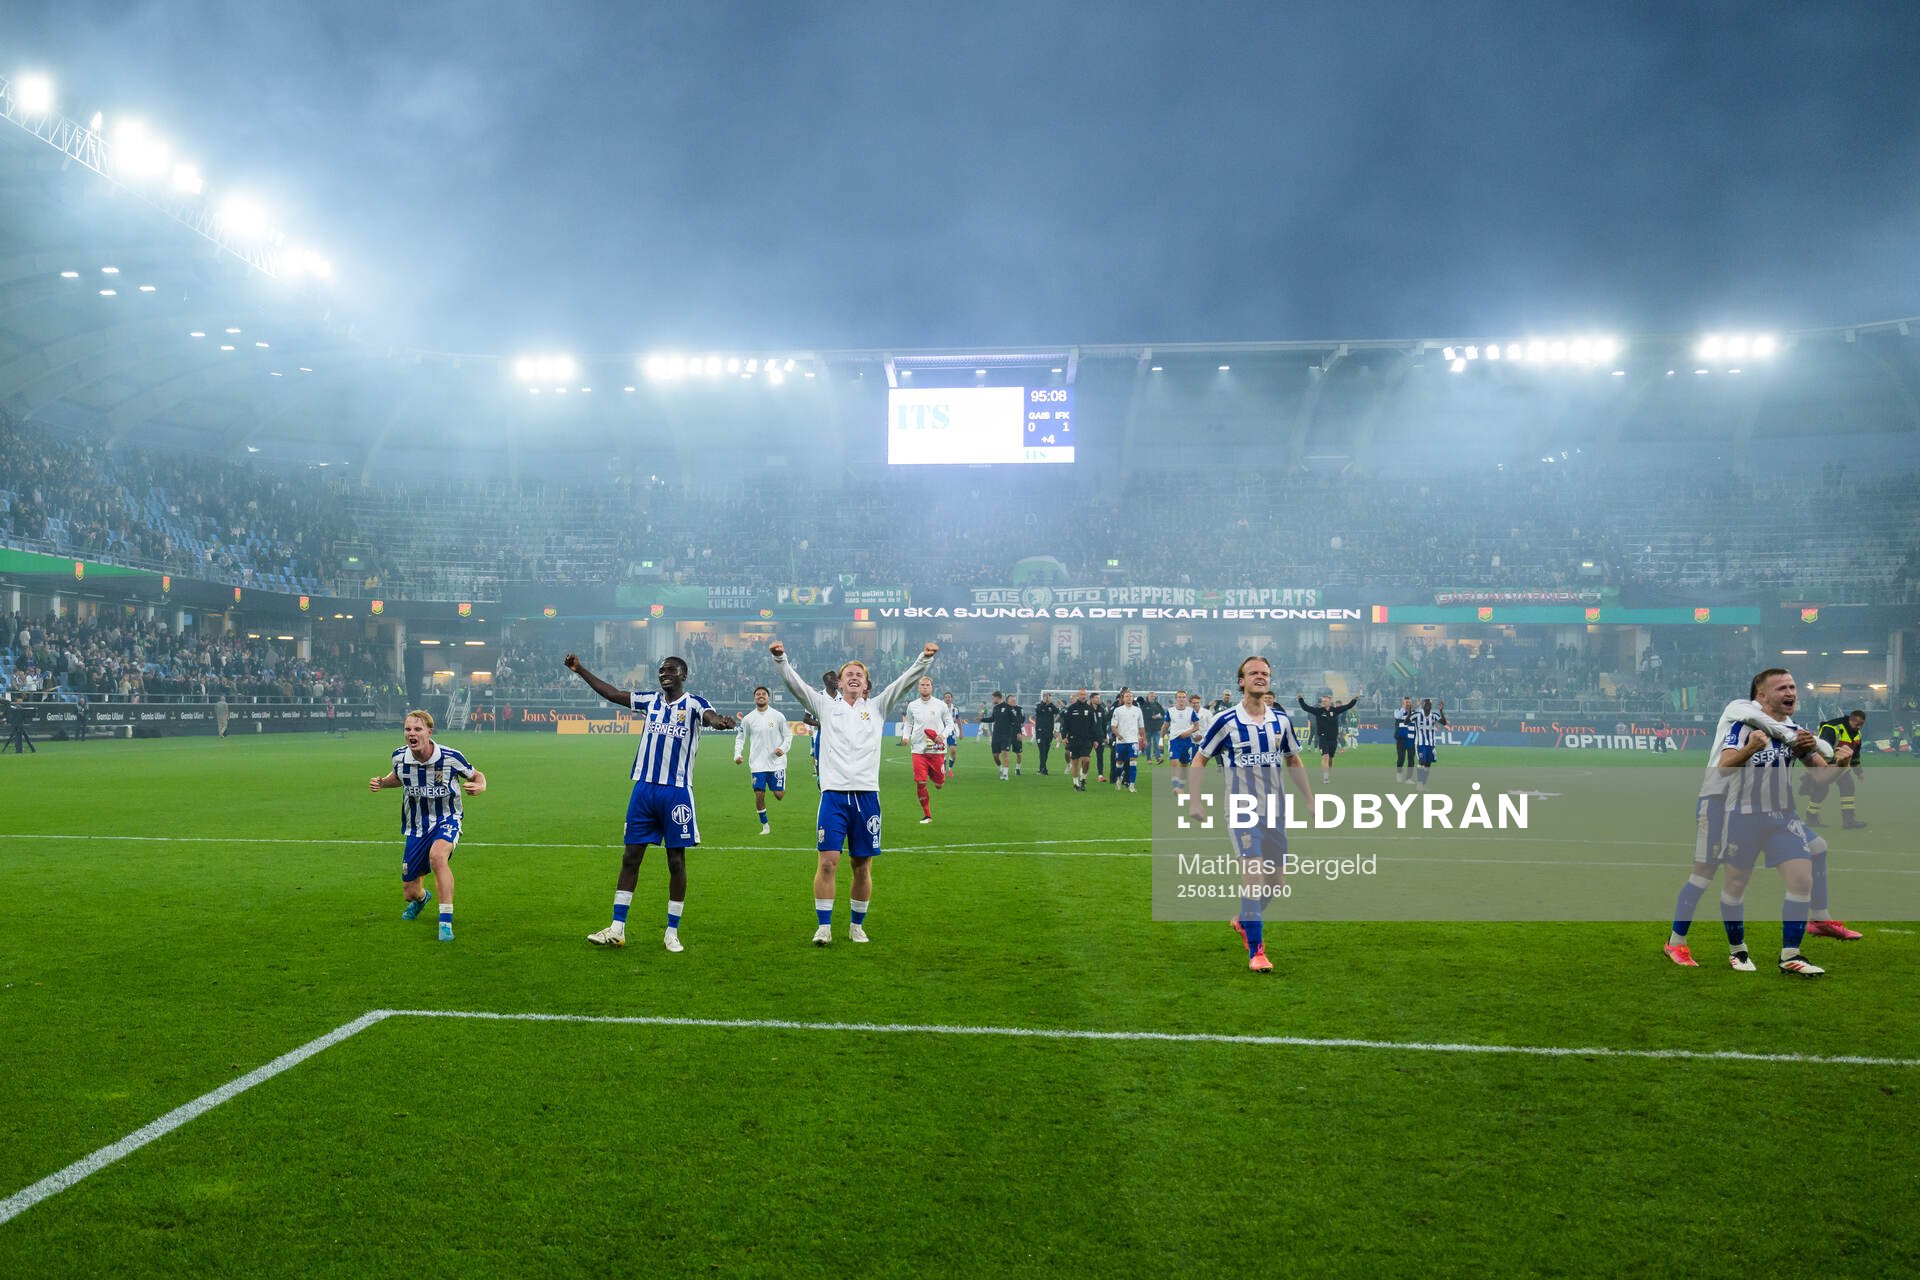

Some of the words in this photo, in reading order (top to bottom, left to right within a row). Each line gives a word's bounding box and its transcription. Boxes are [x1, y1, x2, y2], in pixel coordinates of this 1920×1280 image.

[1030, 390, 1068, 402] 95:08
[896, 404, 952, 430] ITS
[976, 591, 1020, 602] GAIS
[1055, 589, 1101, 602] TIFO
[1108, 586, 1196, 606] PREPPENS
[880, 608, 899, 619] VI
[904, 608, 949, 619] SKA
[953, 608, 1050, 619] SJUNGA
[1089, 608, 1138, 619] DET
[1142, 608, 1206, 619] EKAR
[1223, 608, 1361, 619] BETONGEN
[588, 721, 630, 733] kvdbil
[682, 824, 688, 834] 8
